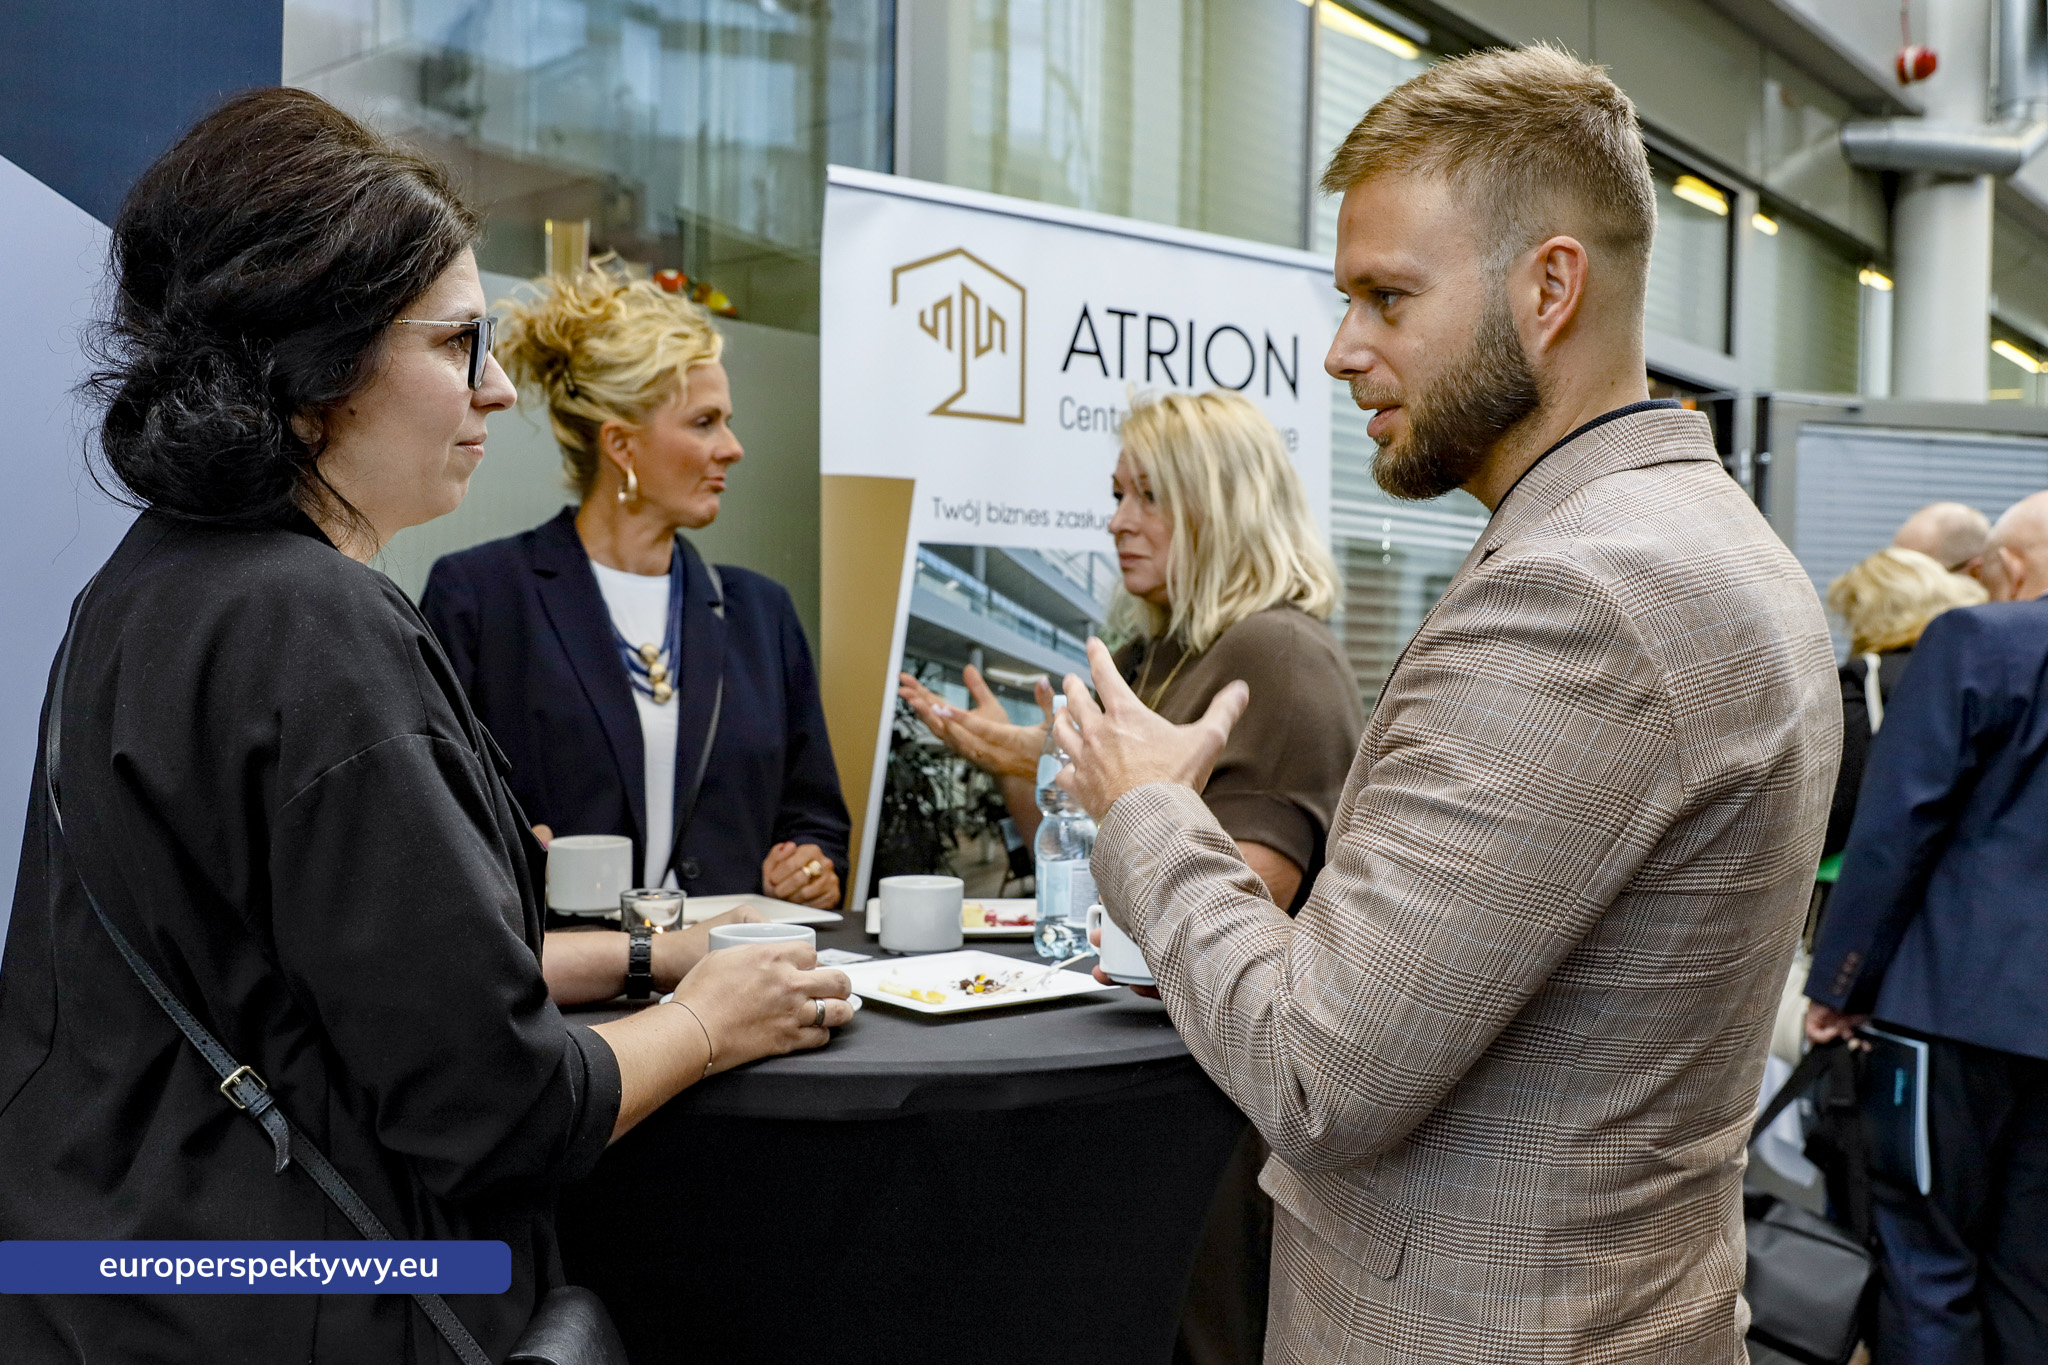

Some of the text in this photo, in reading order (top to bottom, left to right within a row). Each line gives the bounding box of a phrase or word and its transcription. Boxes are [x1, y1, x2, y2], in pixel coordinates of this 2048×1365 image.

[1061, 302, 1299, 399] ATRION
[1059, 396, 1124, 432] Cent
[933, 497, 981, 527] Twój
[986, 502, 1050, 527] biznes
